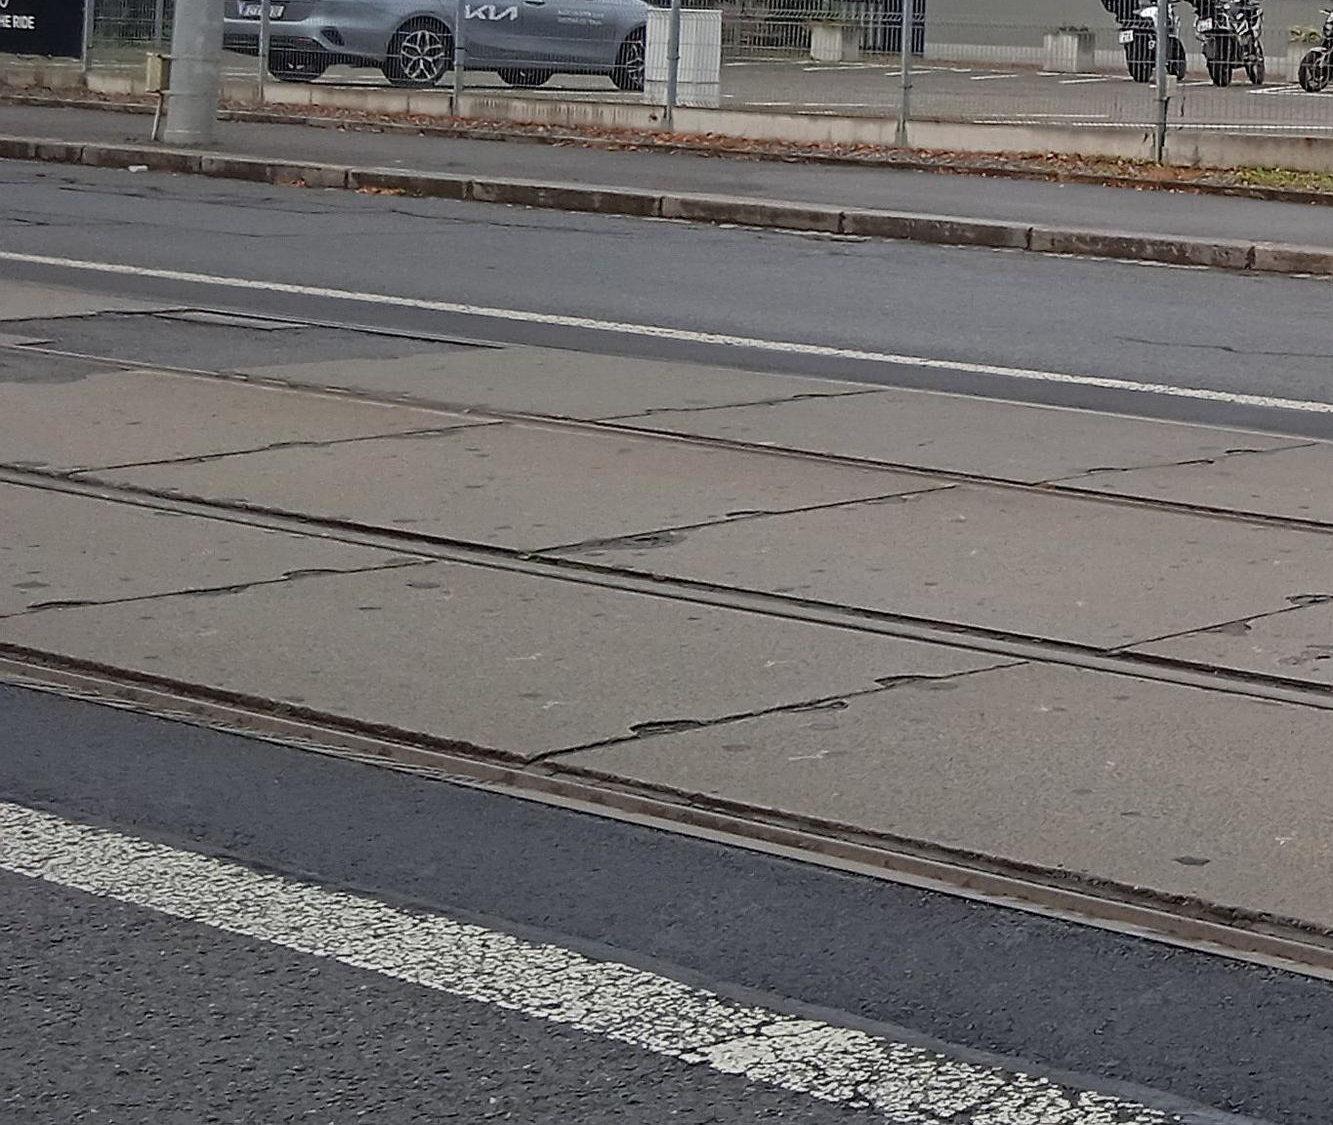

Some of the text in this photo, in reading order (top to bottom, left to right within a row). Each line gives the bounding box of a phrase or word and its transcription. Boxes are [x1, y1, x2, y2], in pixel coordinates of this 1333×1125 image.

[464, 4, 519, 22] KIA
[0, 14, 36, 30] HE RIDE
